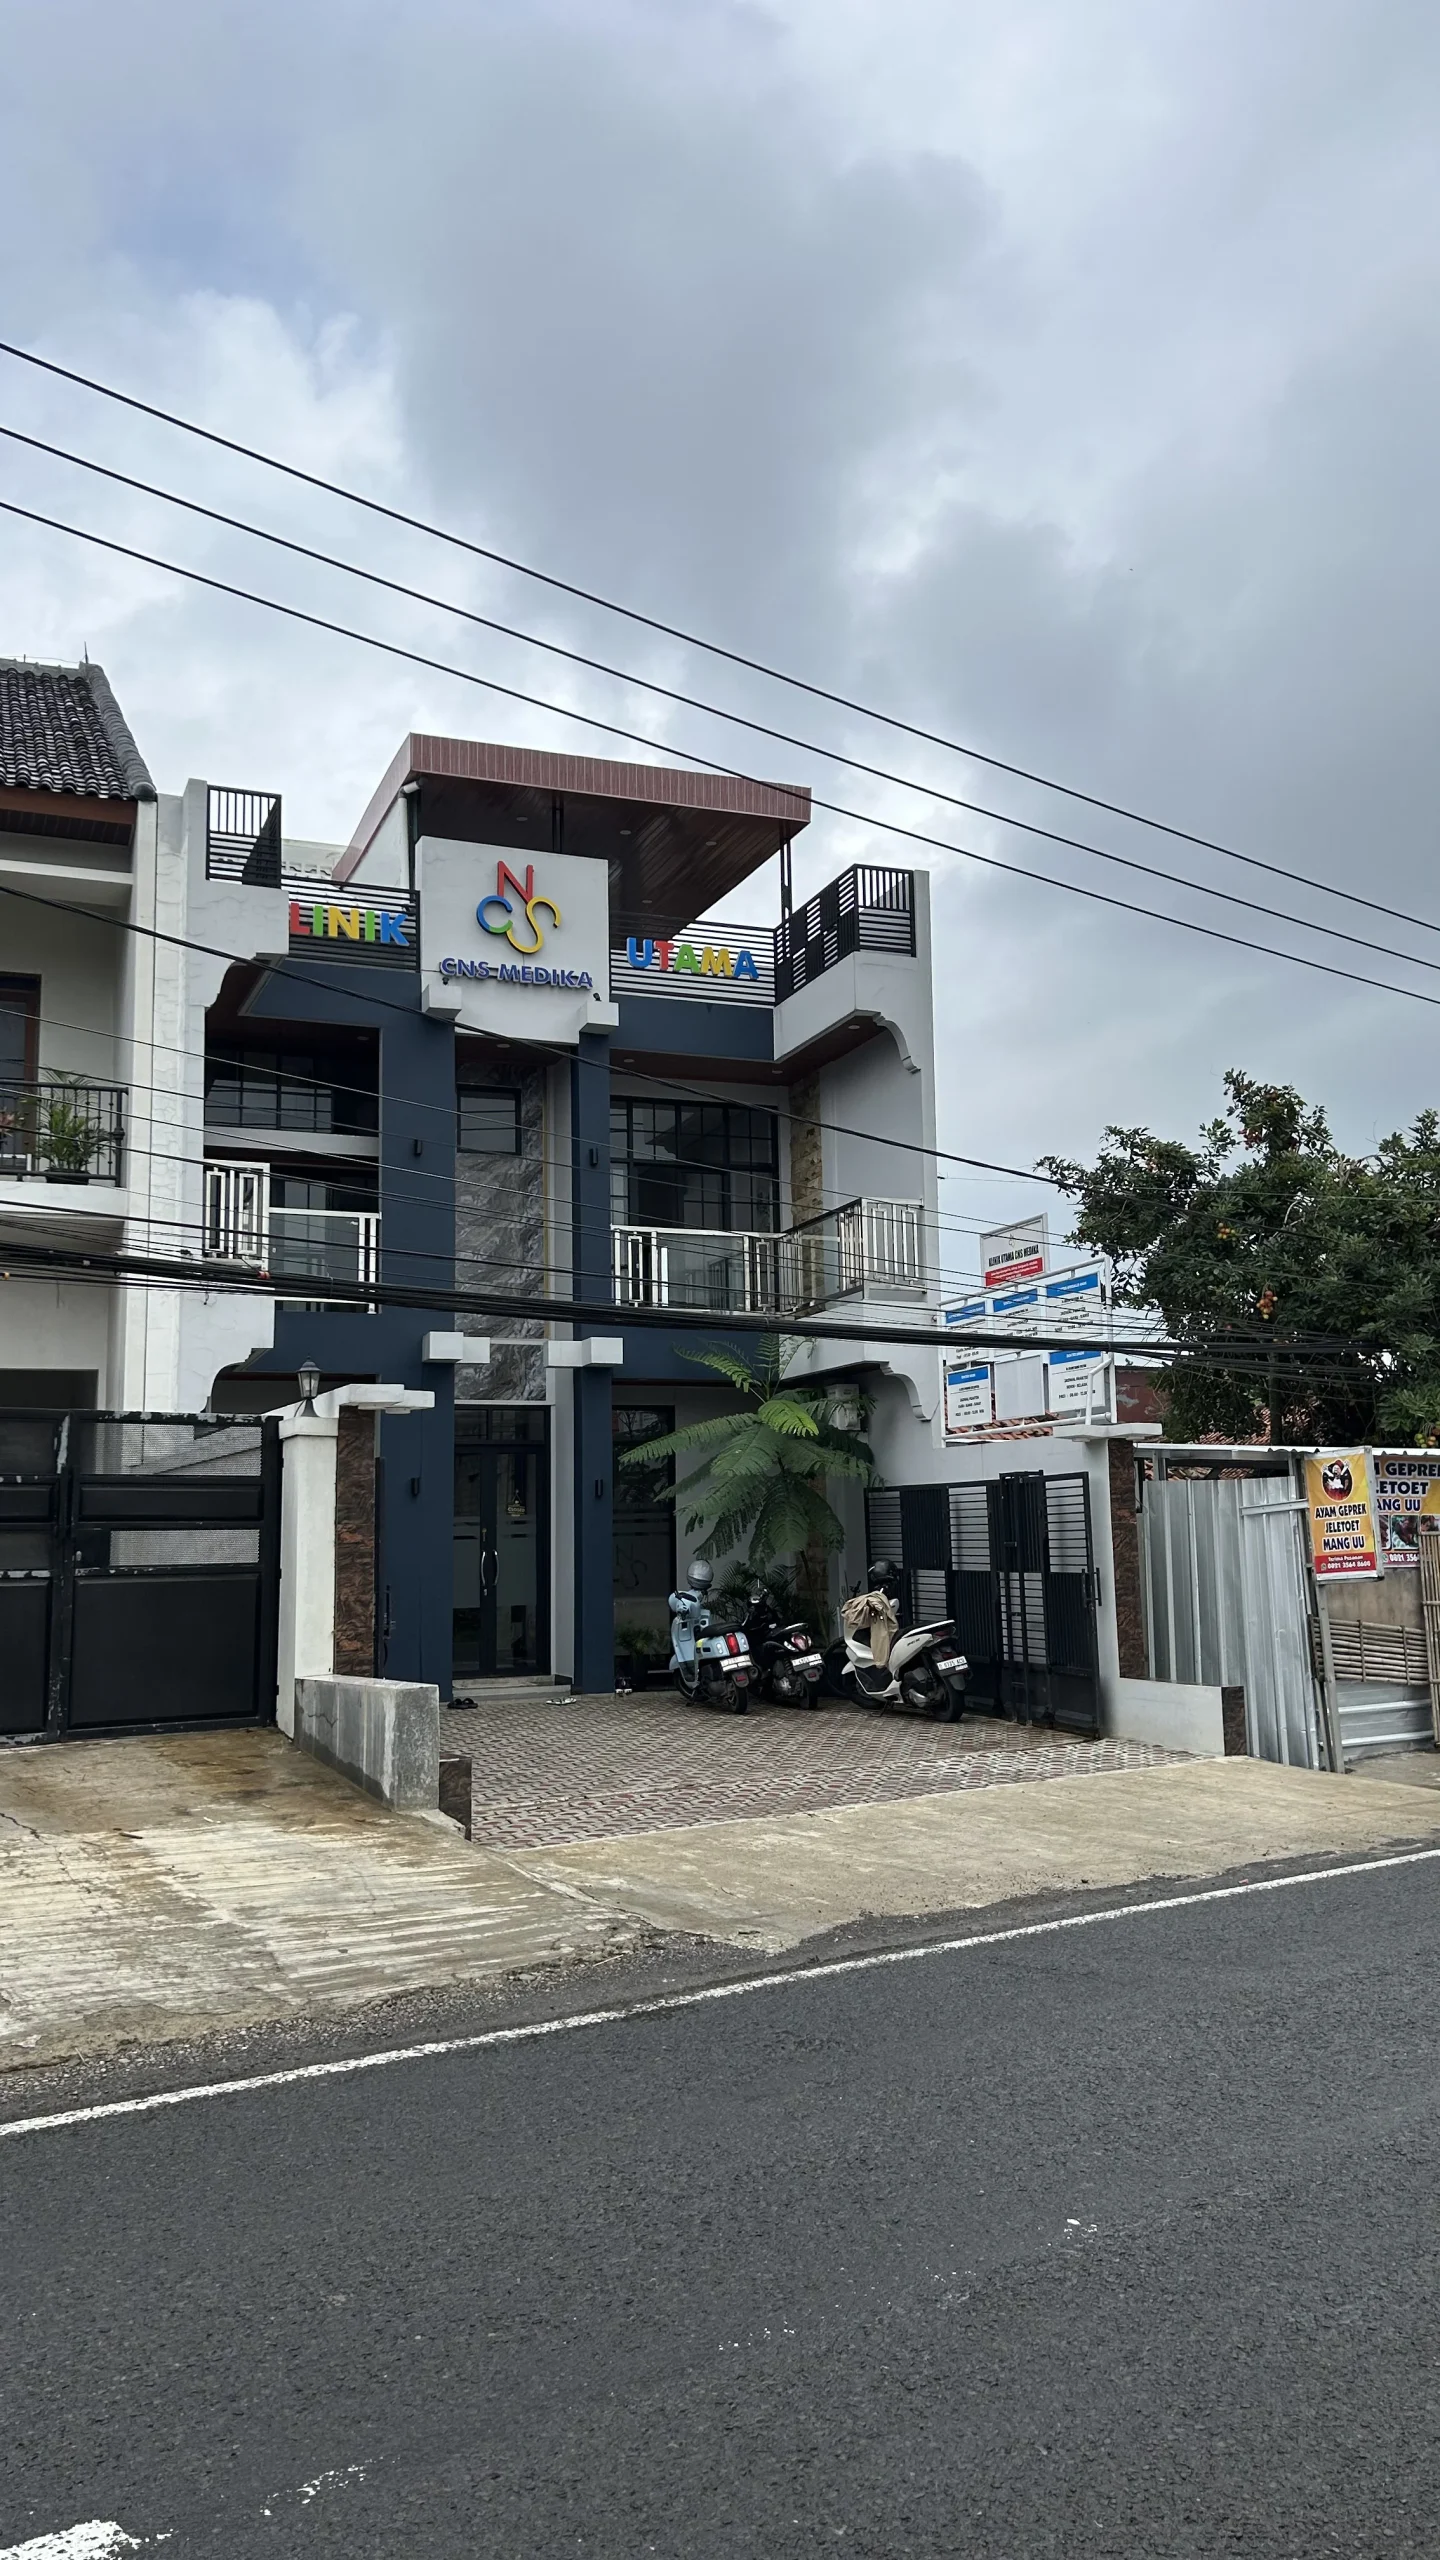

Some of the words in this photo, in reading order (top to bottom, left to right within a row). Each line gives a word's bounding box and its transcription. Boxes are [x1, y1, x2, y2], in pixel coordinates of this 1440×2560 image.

[290, 902, 410, 946] LINIK
[626, 937, 759, 980] UTAMA
[440, 957, 490, 978] CNS
[498, 963, 593, 990] MEDIKA
[1001, 1251, 1014, 1264] UTAMA
[1015, 1249, 1023, 1260] CNS
[1024, 1244, 1039, 1257] MEDIKA
[1376, 1480, 1429, 1495] ETOET
[1315, 1506, 1337, 1519] AYAM
[1338, 1503, 1367, 1516] GEPREK
[1405, 1499, 1421, 1511] UU
[1325, 1519, 1360, 1534] JELETOET
[1323, 1537, 1350, 1551] MANG
[1352, 1535, 1365, 1549] UU
